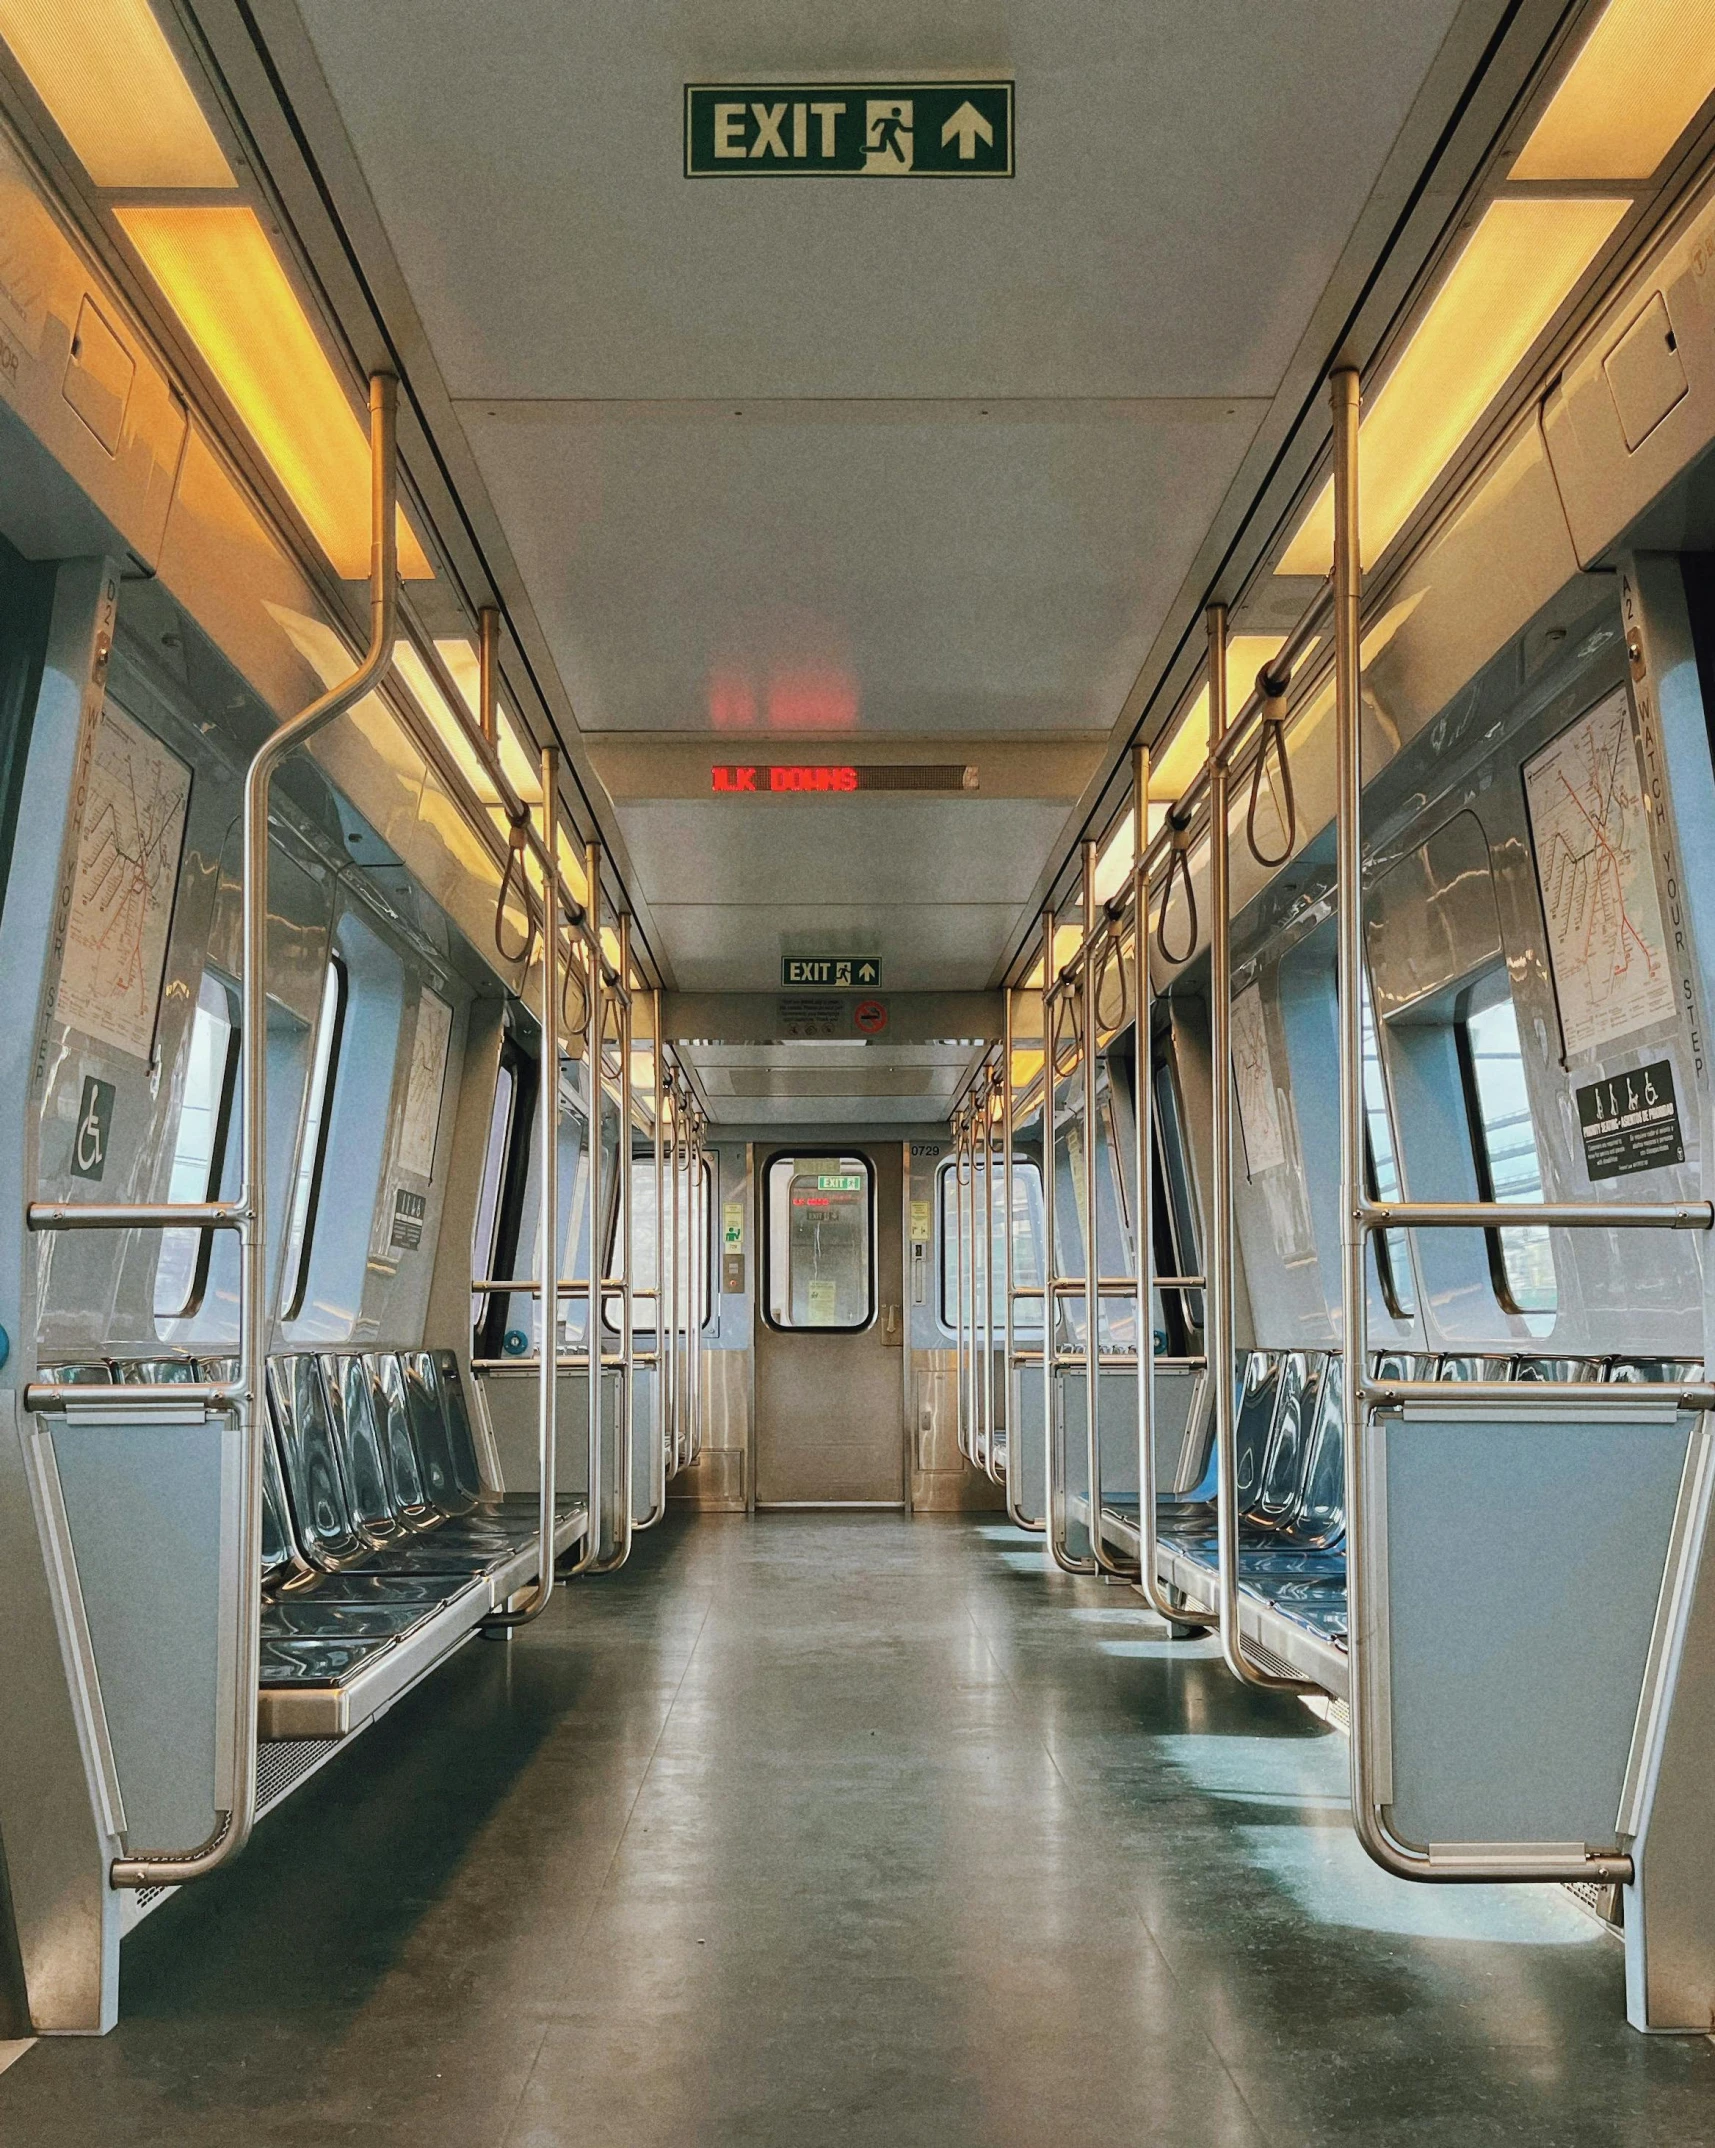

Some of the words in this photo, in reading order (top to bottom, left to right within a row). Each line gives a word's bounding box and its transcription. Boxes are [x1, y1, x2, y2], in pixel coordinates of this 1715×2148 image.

[714, 103, 847, 158] EXIT
[104, 578, 115, 625] D2
[1622, 575, 1634, 620] A2
[72, 707, 98, 833] WATCH
[54, 860, 75, 960] YOUR
[1637, 699, 1666, 826] WATCH
[1662, 852, 1686, 952] YOUR
[1683, 979, 1703, 1079] STEP
[790, 962, 831, 981] EXIT
[36, 986, 55, 1085] STEP
[1601, 1118, 1619, 1133] SEATING
[911, 1145, 940, 1156] 0729
[824, 1177, 844, 1188] EXIT
